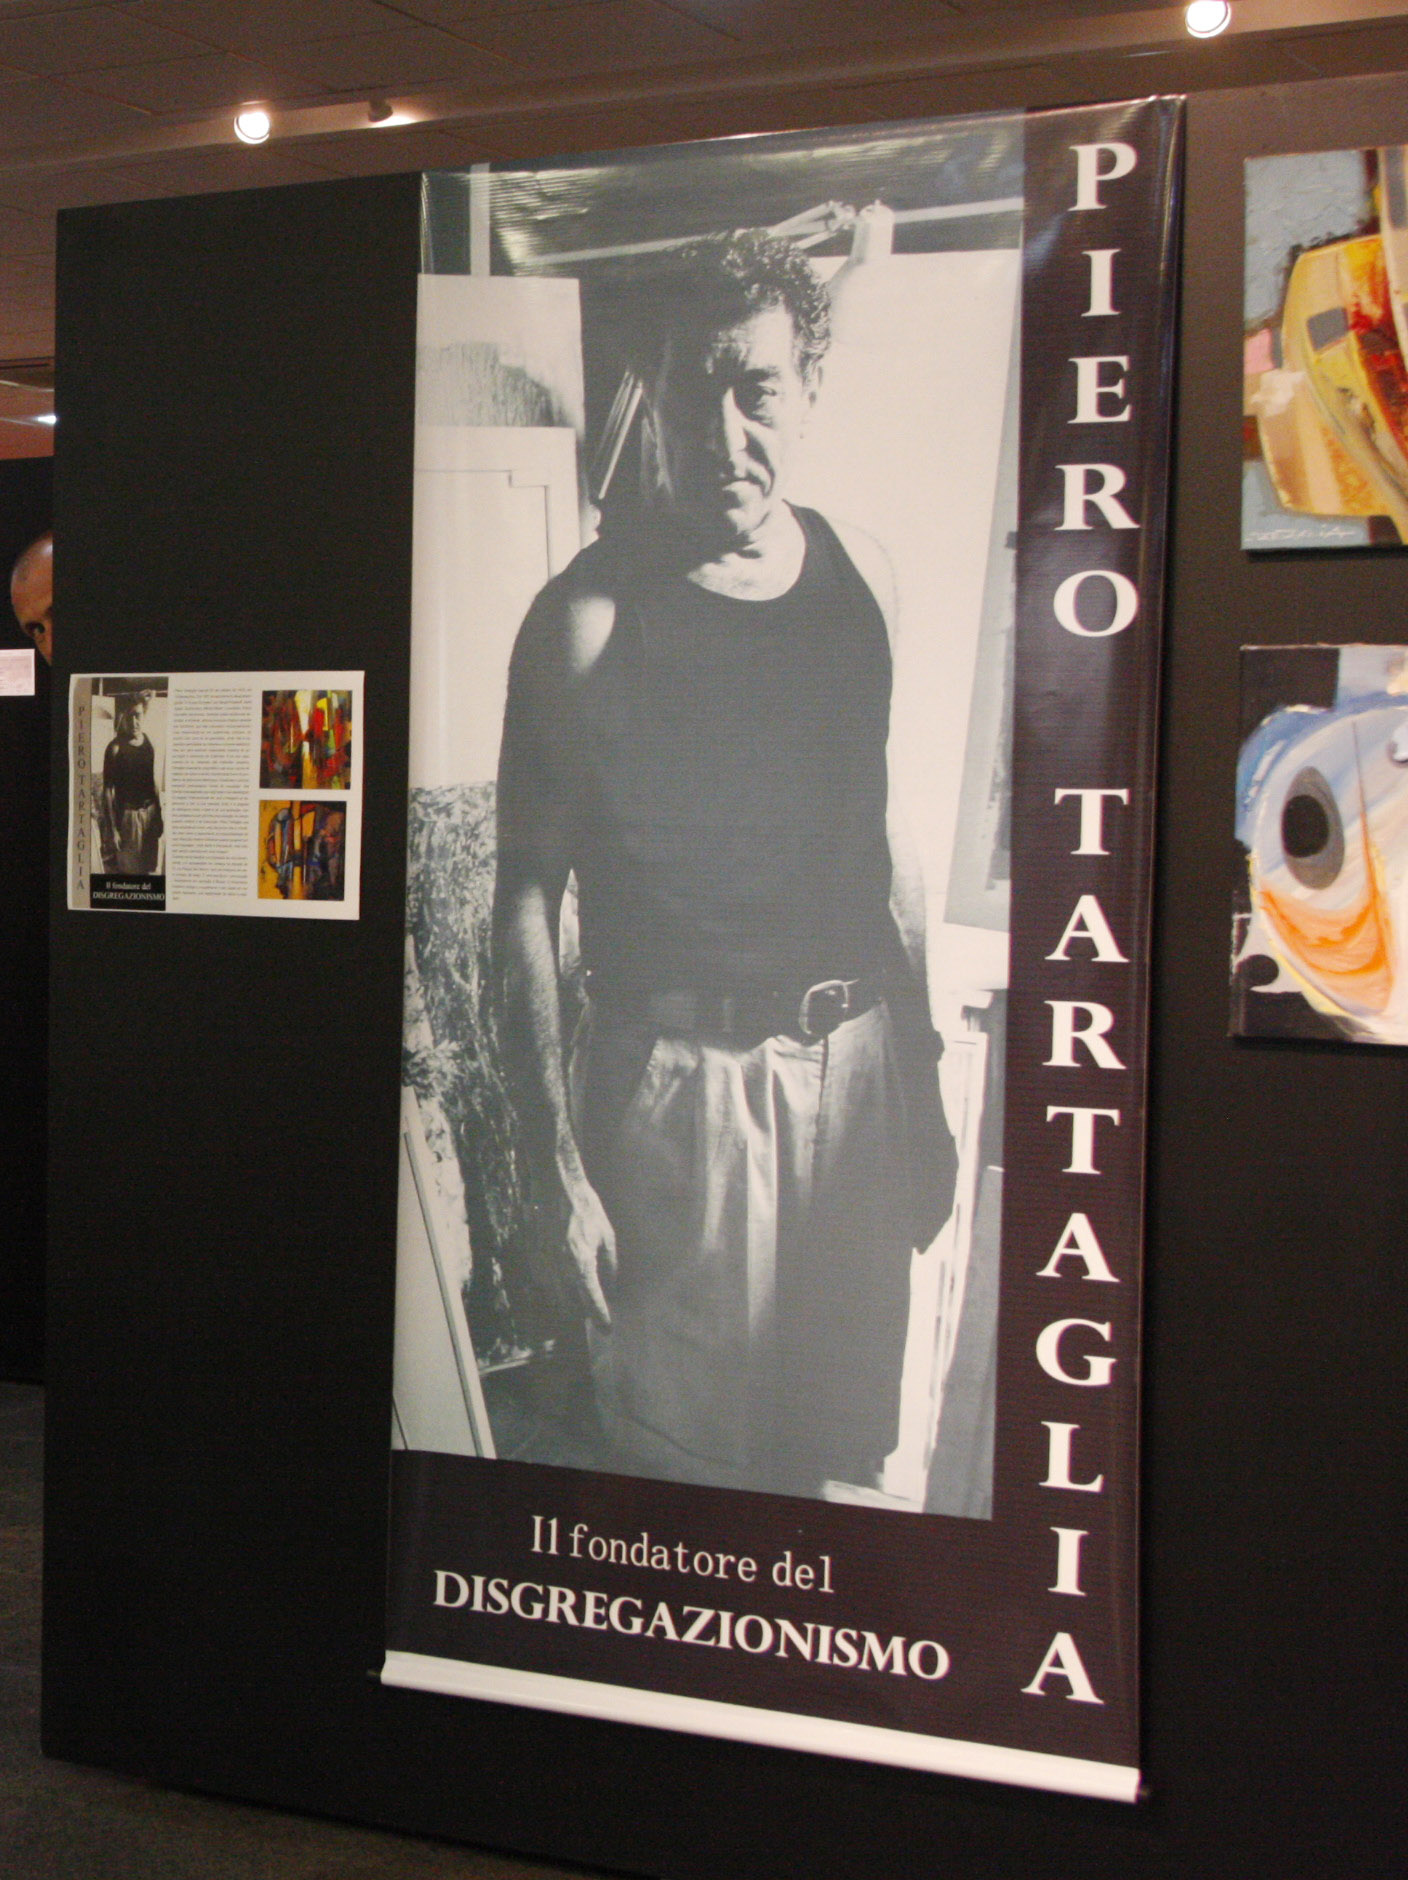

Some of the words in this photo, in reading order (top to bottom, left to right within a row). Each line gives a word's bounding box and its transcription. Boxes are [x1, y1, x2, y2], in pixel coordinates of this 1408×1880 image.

[1051, 140, 1140, 640] PIERO
[92, 891, 165, 900] DISGREGAZIONISMO
[1021, 786, 1130, 1705] TARTAGLIA
[530, 1514, 560, 1555] Il
[568, 1523, 758, 1583] fondatore
[770, 1550, 835, 1595] del
[432, 1569, 952, 1682] DISGREGAZIONISMO
